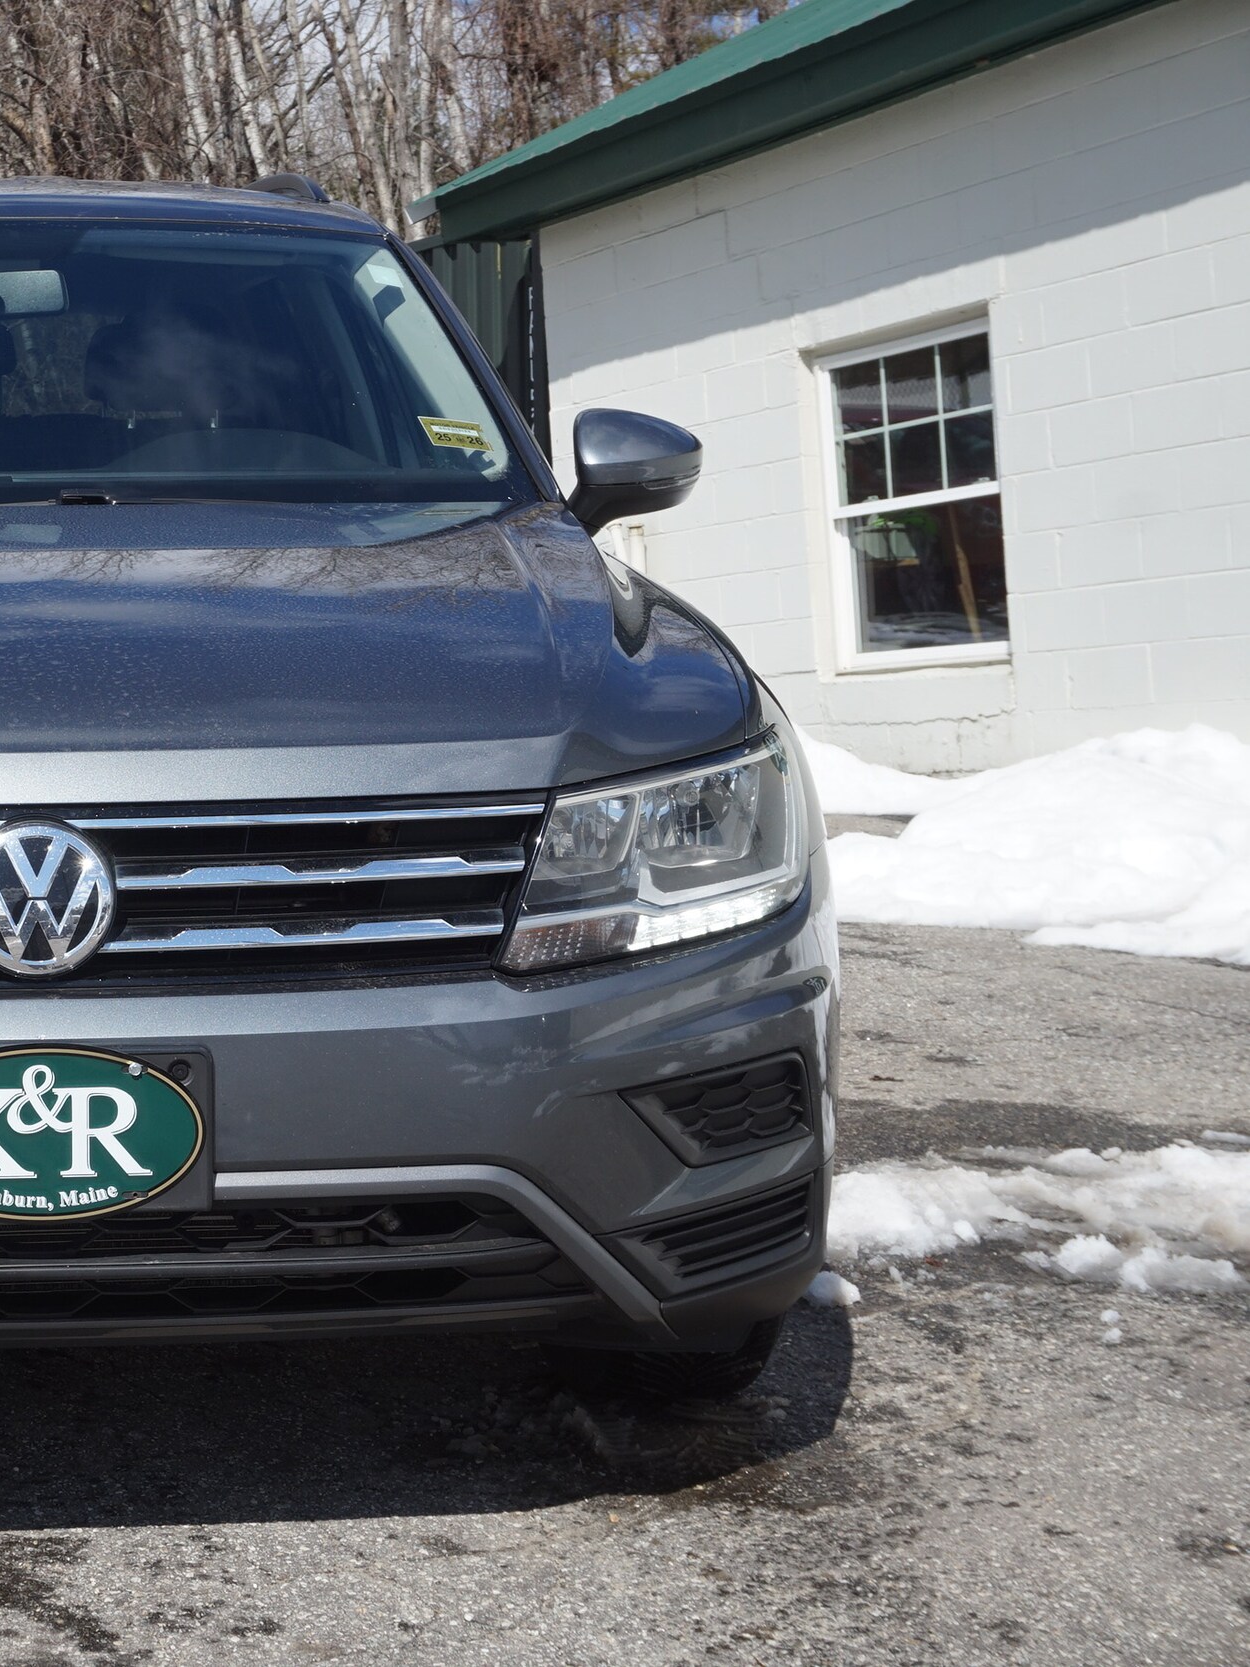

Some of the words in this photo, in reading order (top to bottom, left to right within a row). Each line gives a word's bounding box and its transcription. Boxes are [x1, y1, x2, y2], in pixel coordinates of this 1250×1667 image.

[435, 432, 452, 442] 25
[467, 436, 484, 446] 26
[59, 1184, 119, 1207] Maine
